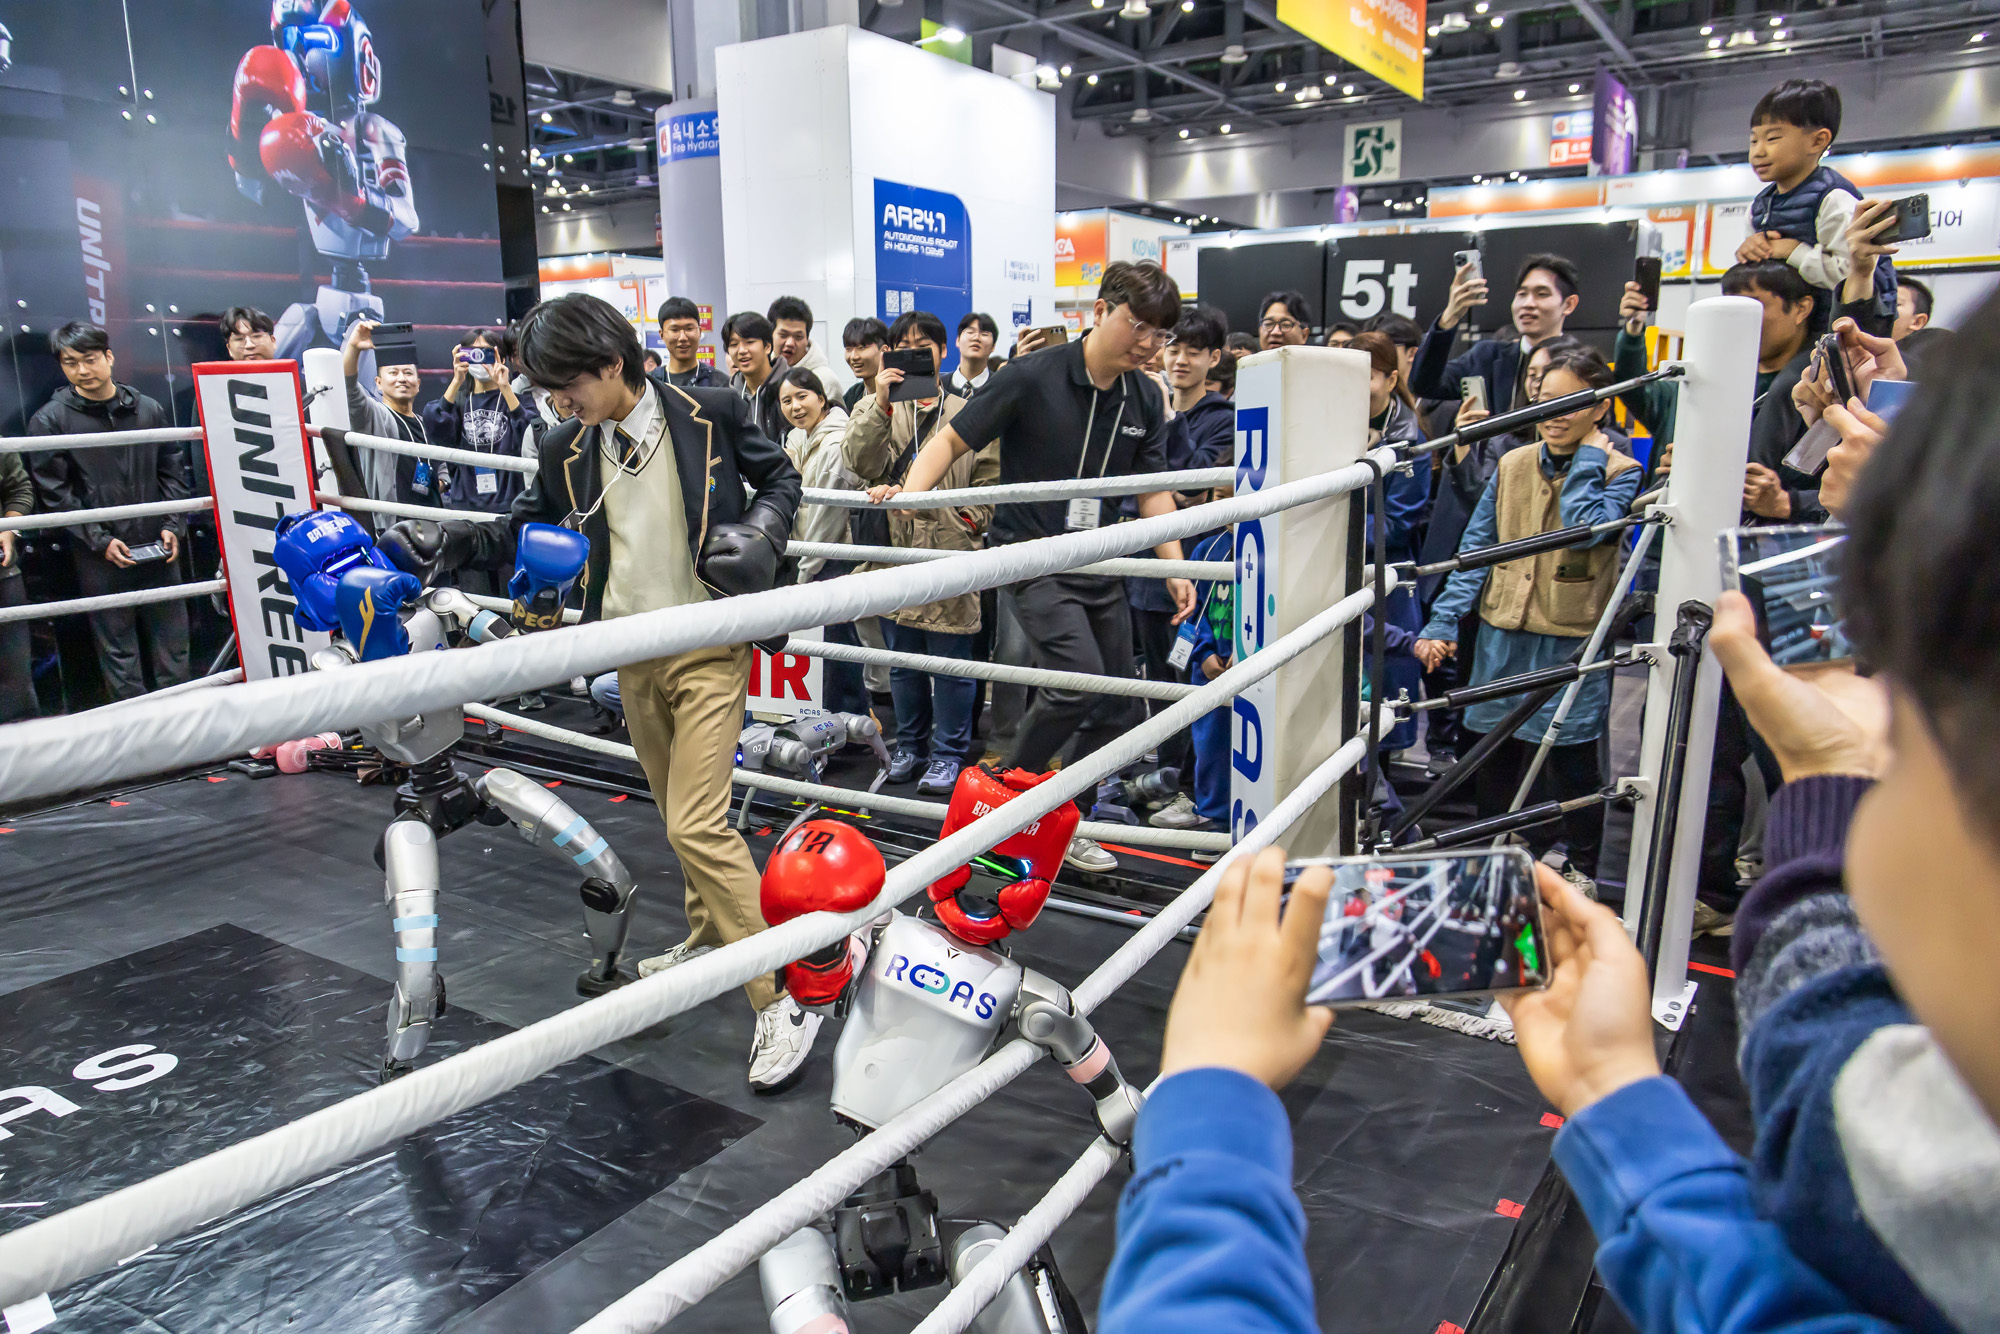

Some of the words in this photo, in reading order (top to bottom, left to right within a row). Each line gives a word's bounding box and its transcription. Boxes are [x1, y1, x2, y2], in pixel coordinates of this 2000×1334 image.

[883, 203, 946, 234] AR24.7
[1657, 207, 1682, 219] A10
[1930, 209, 1963, 228] 디어
[884, 230, 935, 245] AUTONOMOUS
[77, 197, 111, 328] UNITR
[1340, 259, 1418, 319] 5t
